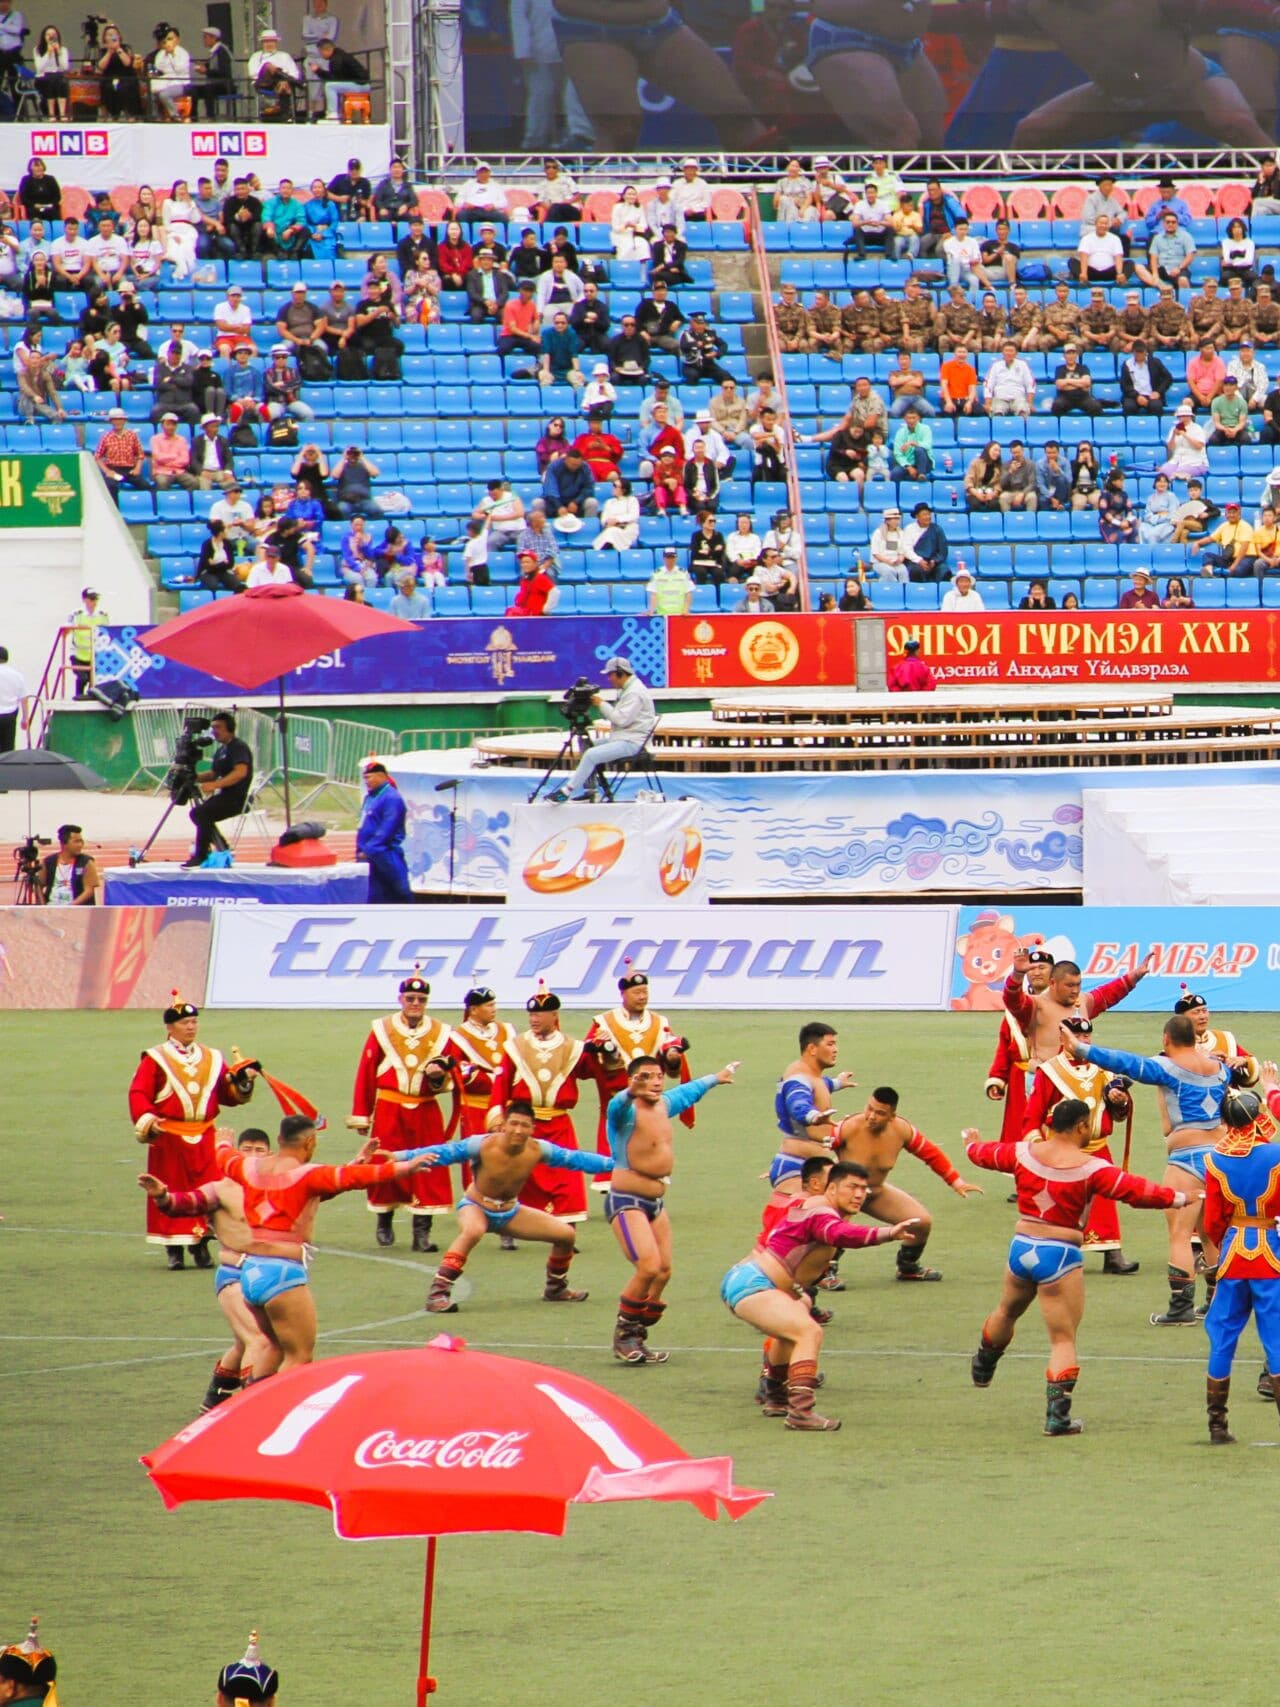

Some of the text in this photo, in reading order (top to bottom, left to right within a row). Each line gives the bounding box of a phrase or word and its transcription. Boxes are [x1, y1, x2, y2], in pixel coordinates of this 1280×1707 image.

[33, 132, 108, 154] MNB
[193, 132, 267, 155] MNB
[887, 623, 1001, 656] ОНГОЛ
[1179, 622, 1251, 654] ХХК
[1006, 659, 1079, 679] Анхдагч
[269, 917, 888, 997] East japan
[1084, 943, 1259, 976] БАМБАР
[354, 1430, 530, 1469] Coca-Cola
